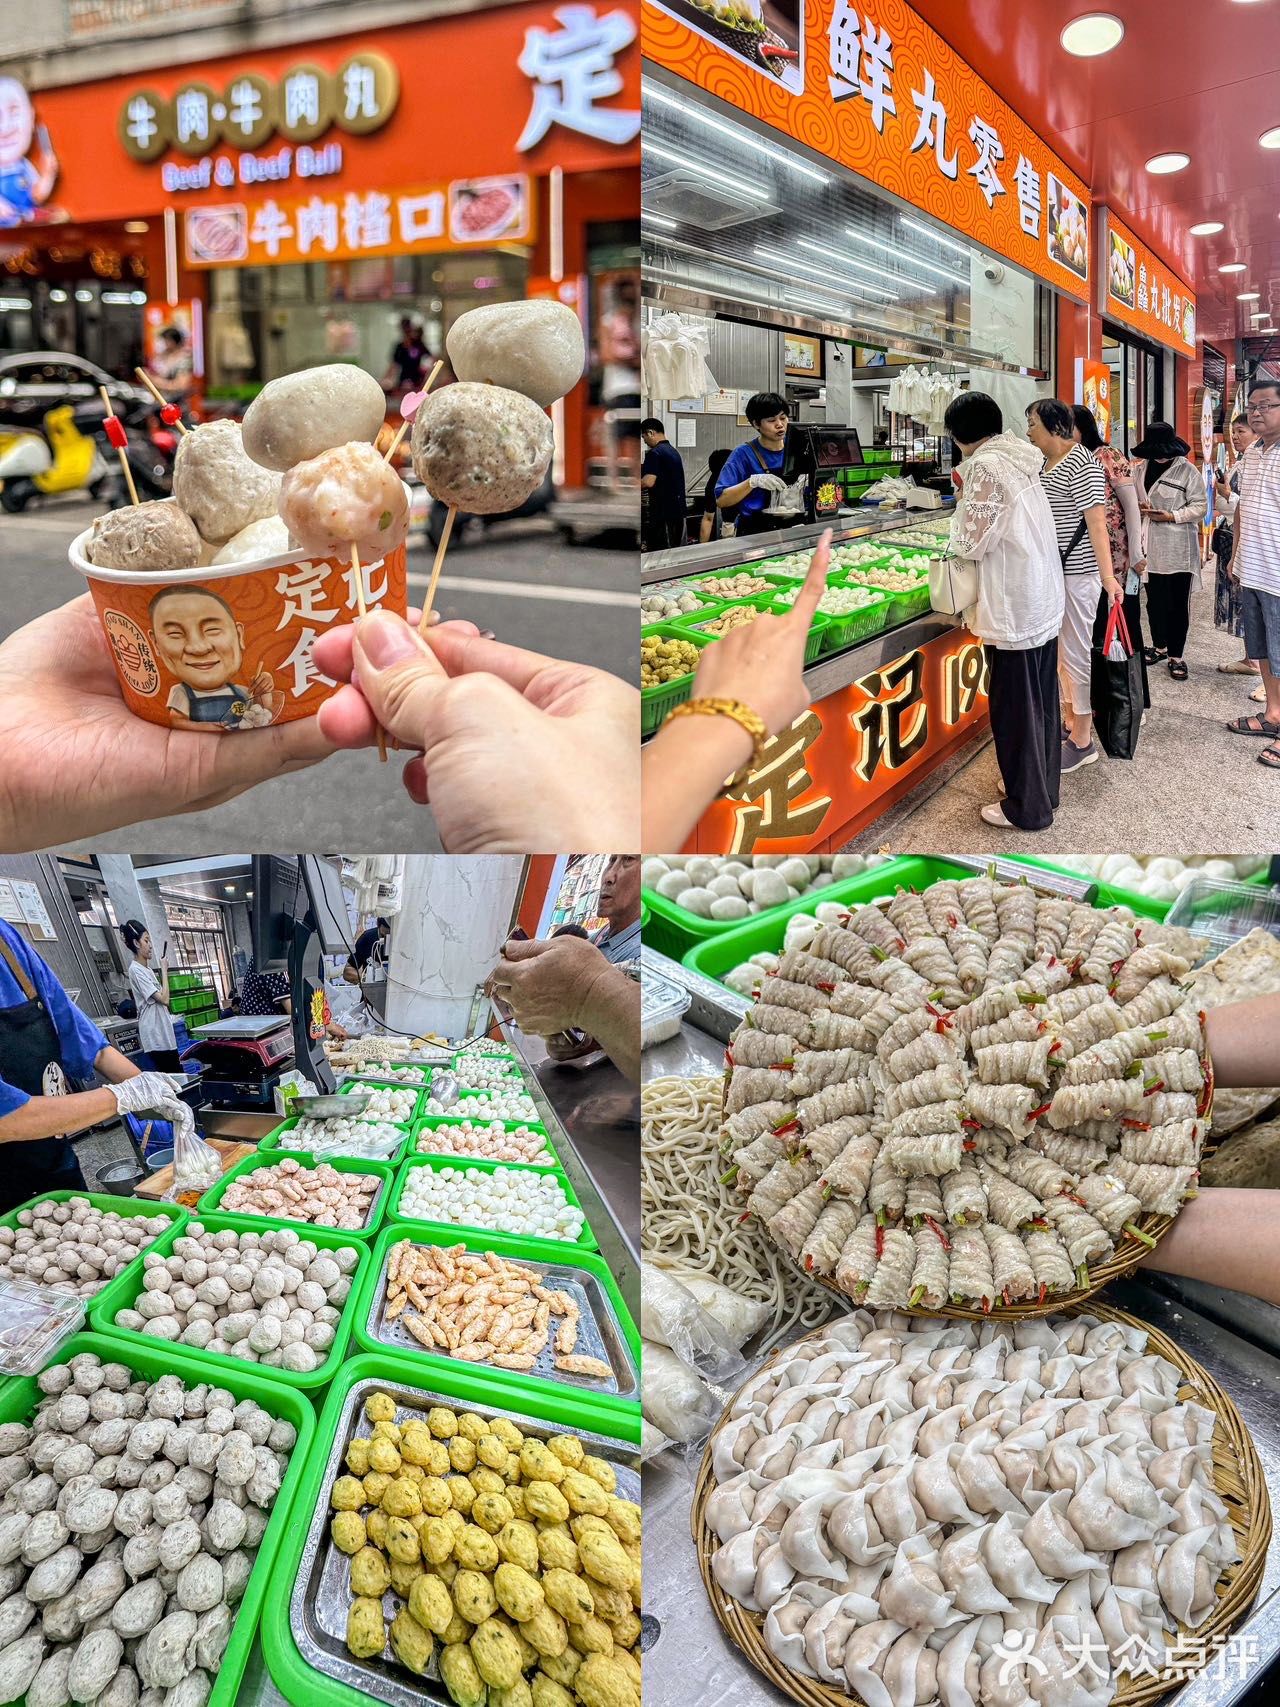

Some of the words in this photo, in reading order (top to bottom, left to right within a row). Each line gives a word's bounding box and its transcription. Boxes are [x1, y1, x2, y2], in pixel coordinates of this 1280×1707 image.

[514, 3, 640, 152] 定
[826, 0, 1041, 240] 鲜丸零售
[162, 156, 213, 192] Beef
[214, 156, 235, 187] &
[239, 146, 292, 184] Beef
[296, 143, 342, 177] Ball
[251, 191, 446, 256] 牛肉档口
